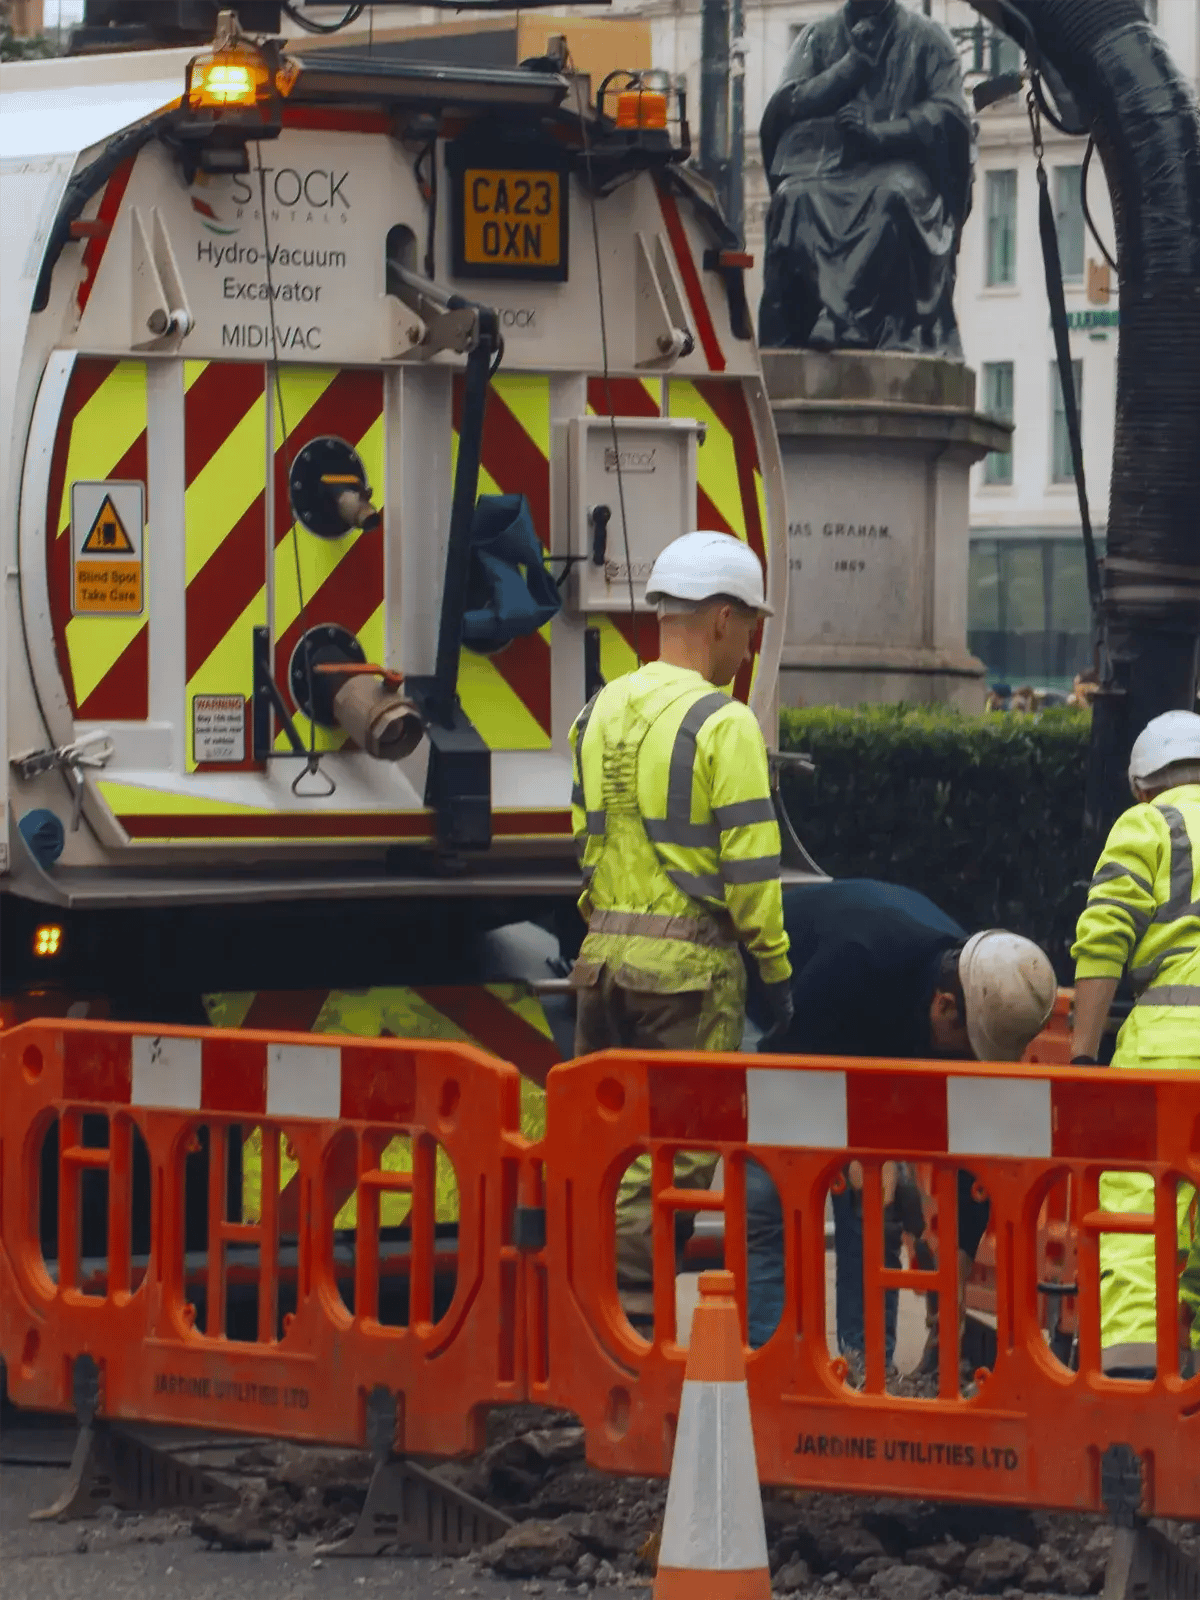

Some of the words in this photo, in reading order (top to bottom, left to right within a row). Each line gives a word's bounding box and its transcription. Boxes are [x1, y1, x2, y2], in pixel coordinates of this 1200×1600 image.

[231, 168, 350, 209] STOCK
[473, 177, 551, 215] CA23
[483, 221, 542, 258] OXN
[197, 240, 346, 269] Hydro-Vacuum
[223, 276, 322, 303] Excavator
[79, 570, 108, 584] Blind
[111, 570, 136, 585] Spot
[81, 588, 107, 602] Take
[109, 589, 136, 602] Care
[197, 699, 242, 710] WARNING
[794, 1433, 876, 1460] JARDINE
[884, 1439, 975, 1468] UTILITIES
[981, 1445, 1019, 1471] LTD
